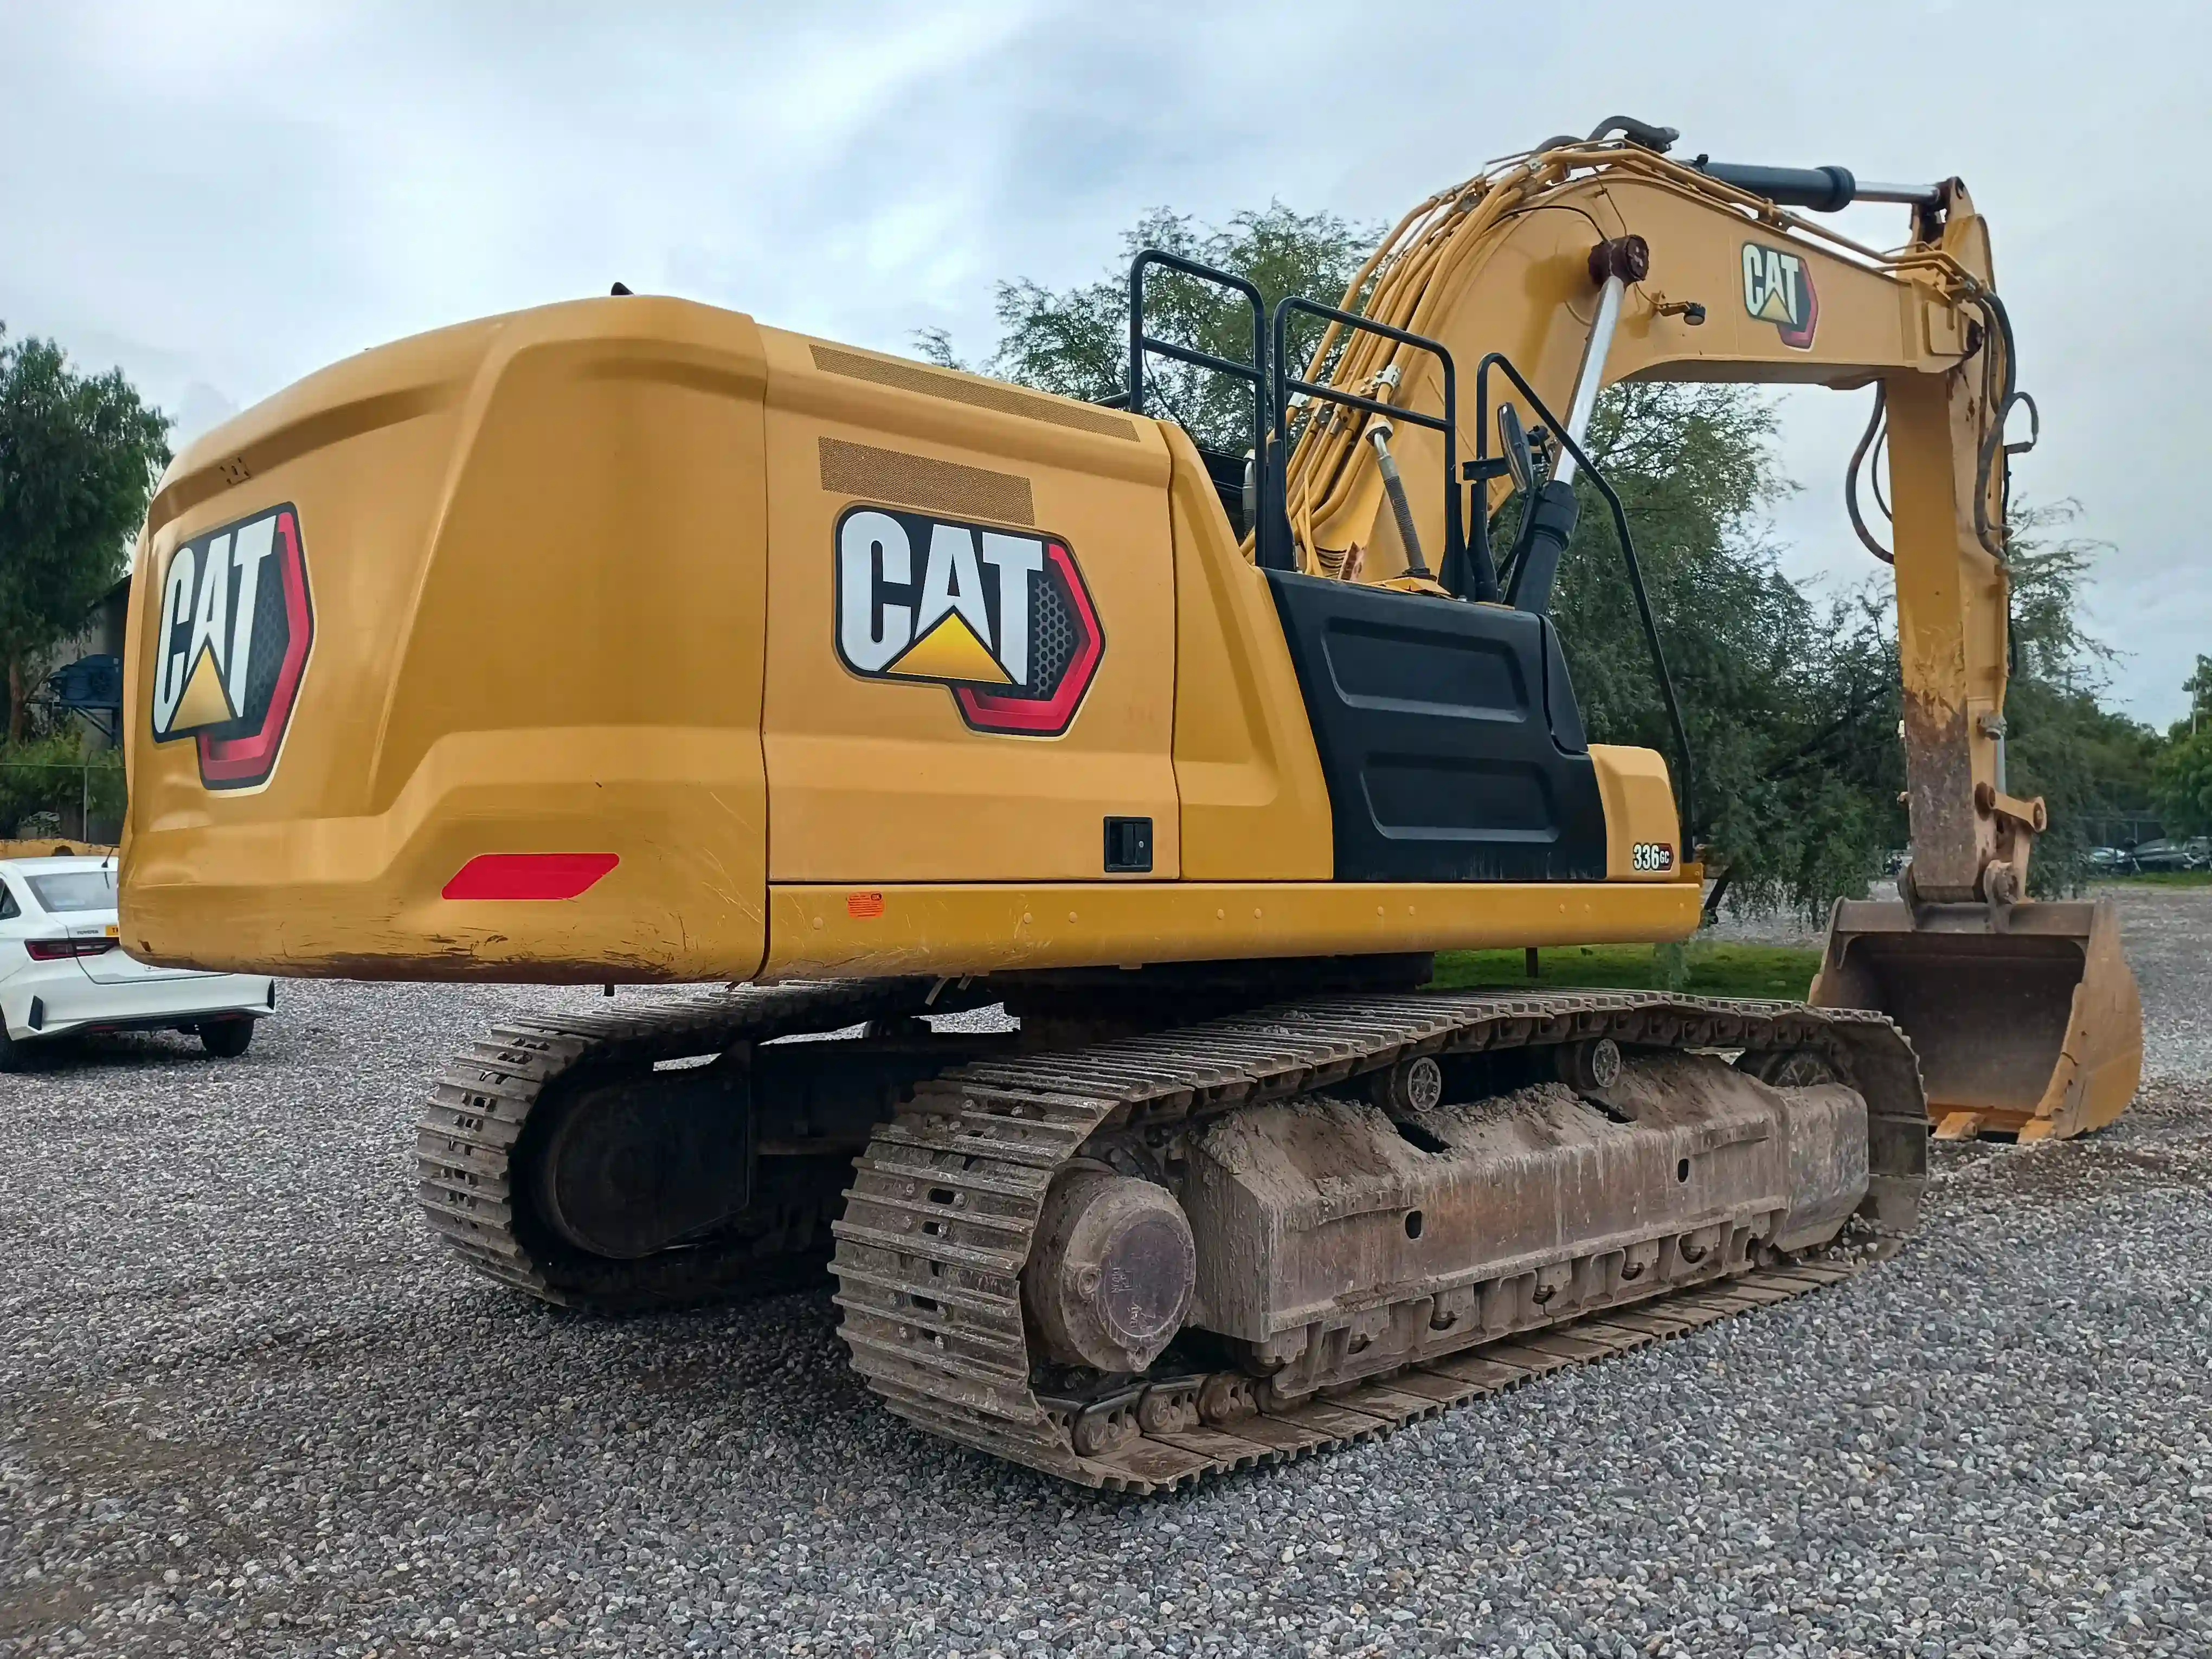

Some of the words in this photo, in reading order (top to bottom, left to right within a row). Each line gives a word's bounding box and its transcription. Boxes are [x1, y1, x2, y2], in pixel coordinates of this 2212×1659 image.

[1742, 244, 1799, 325] CAT
[153, 515, 277, 734] CAT
[841, 511, 1043, 686] CAT
[1633, 844, 1659, 870] 336
[1660, 851, 1669, 864] GC
